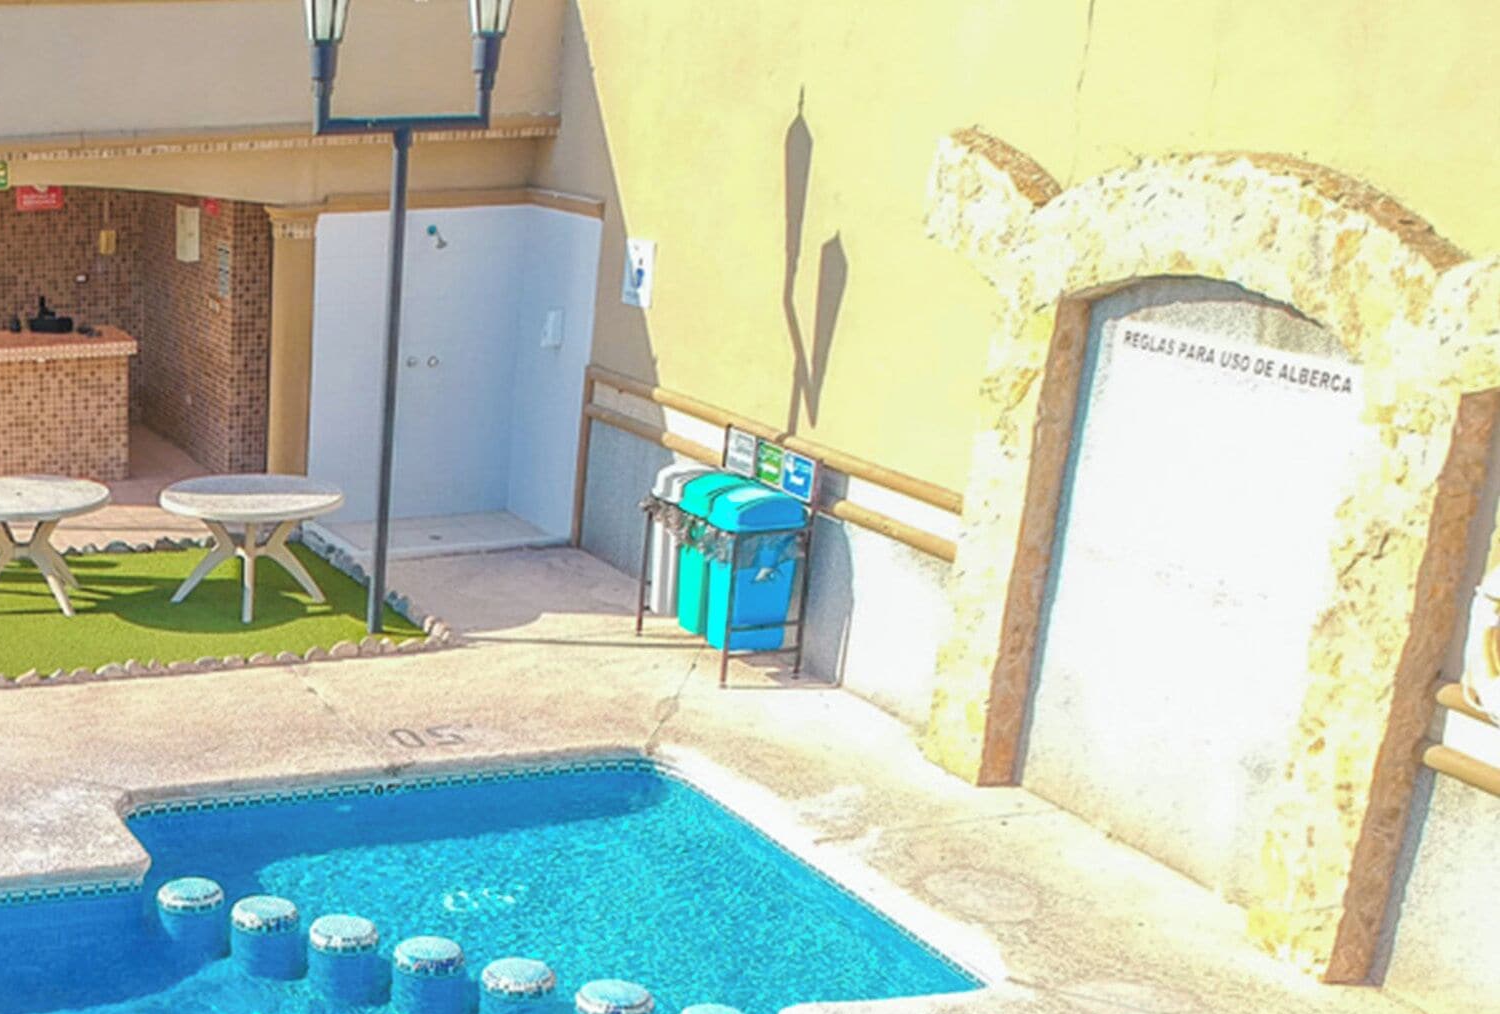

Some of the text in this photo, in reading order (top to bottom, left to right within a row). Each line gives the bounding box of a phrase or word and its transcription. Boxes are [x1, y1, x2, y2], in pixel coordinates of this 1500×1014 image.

[1123, 330, 1353, 393] REGLAS PARA USO DE ALBERCA
